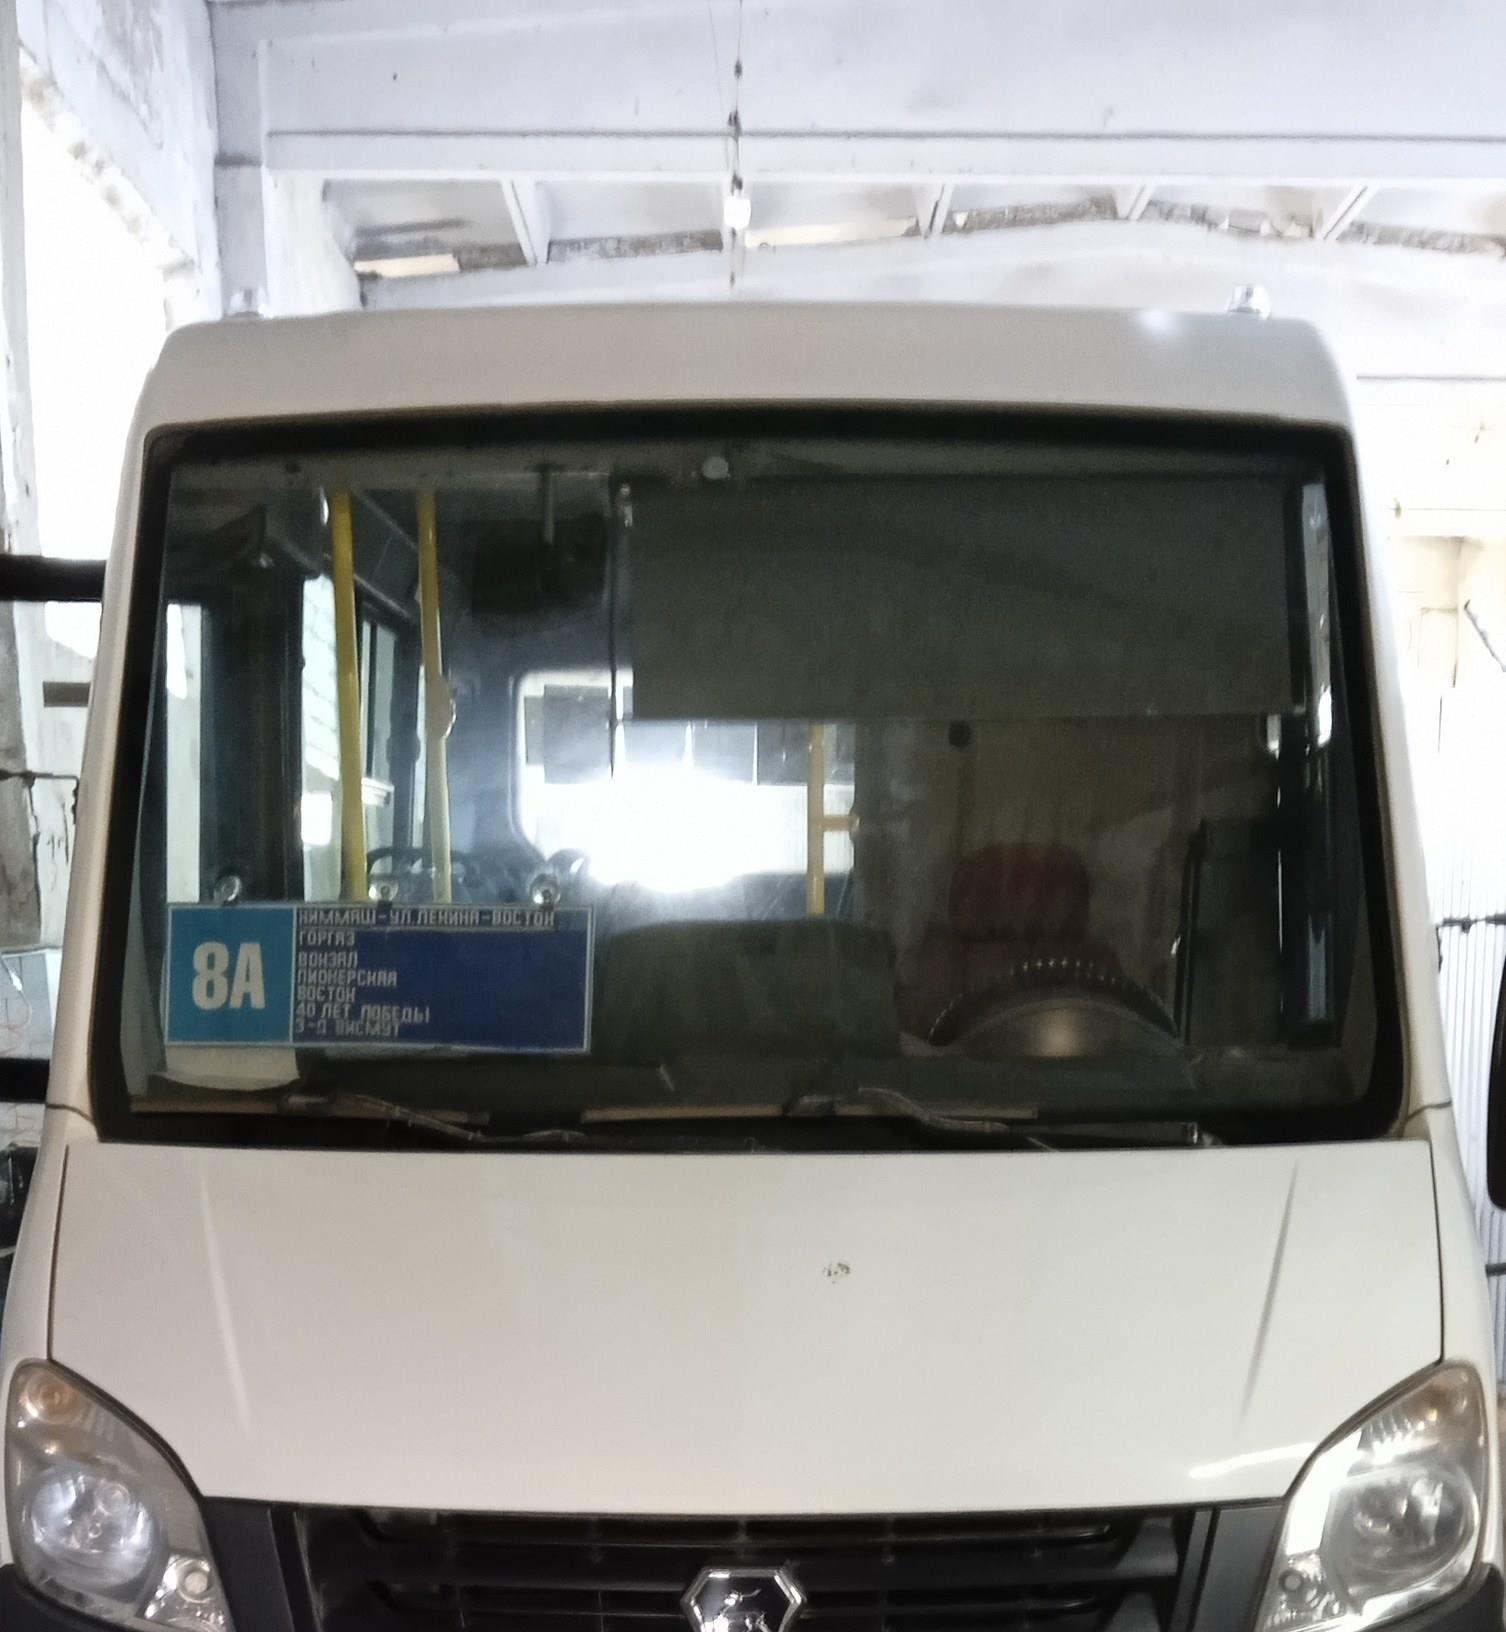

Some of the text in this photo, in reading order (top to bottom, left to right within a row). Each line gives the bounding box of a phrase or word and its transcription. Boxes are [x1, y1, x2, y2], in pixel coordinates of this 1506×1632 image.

[299, 930, 356, 947] ГОРГАЗ
[298, 951, 359, 969] ВОКЗАЛ
[192, 942, 266, 1010] 8А
[297, 968, 398, 987] ПИОНЕРСКАЯ
[297, 985, 356, 1003] ВОСТОК
[296, 1001, 430, 1024] 40 ЛЕТ ПОБЕДЫ
